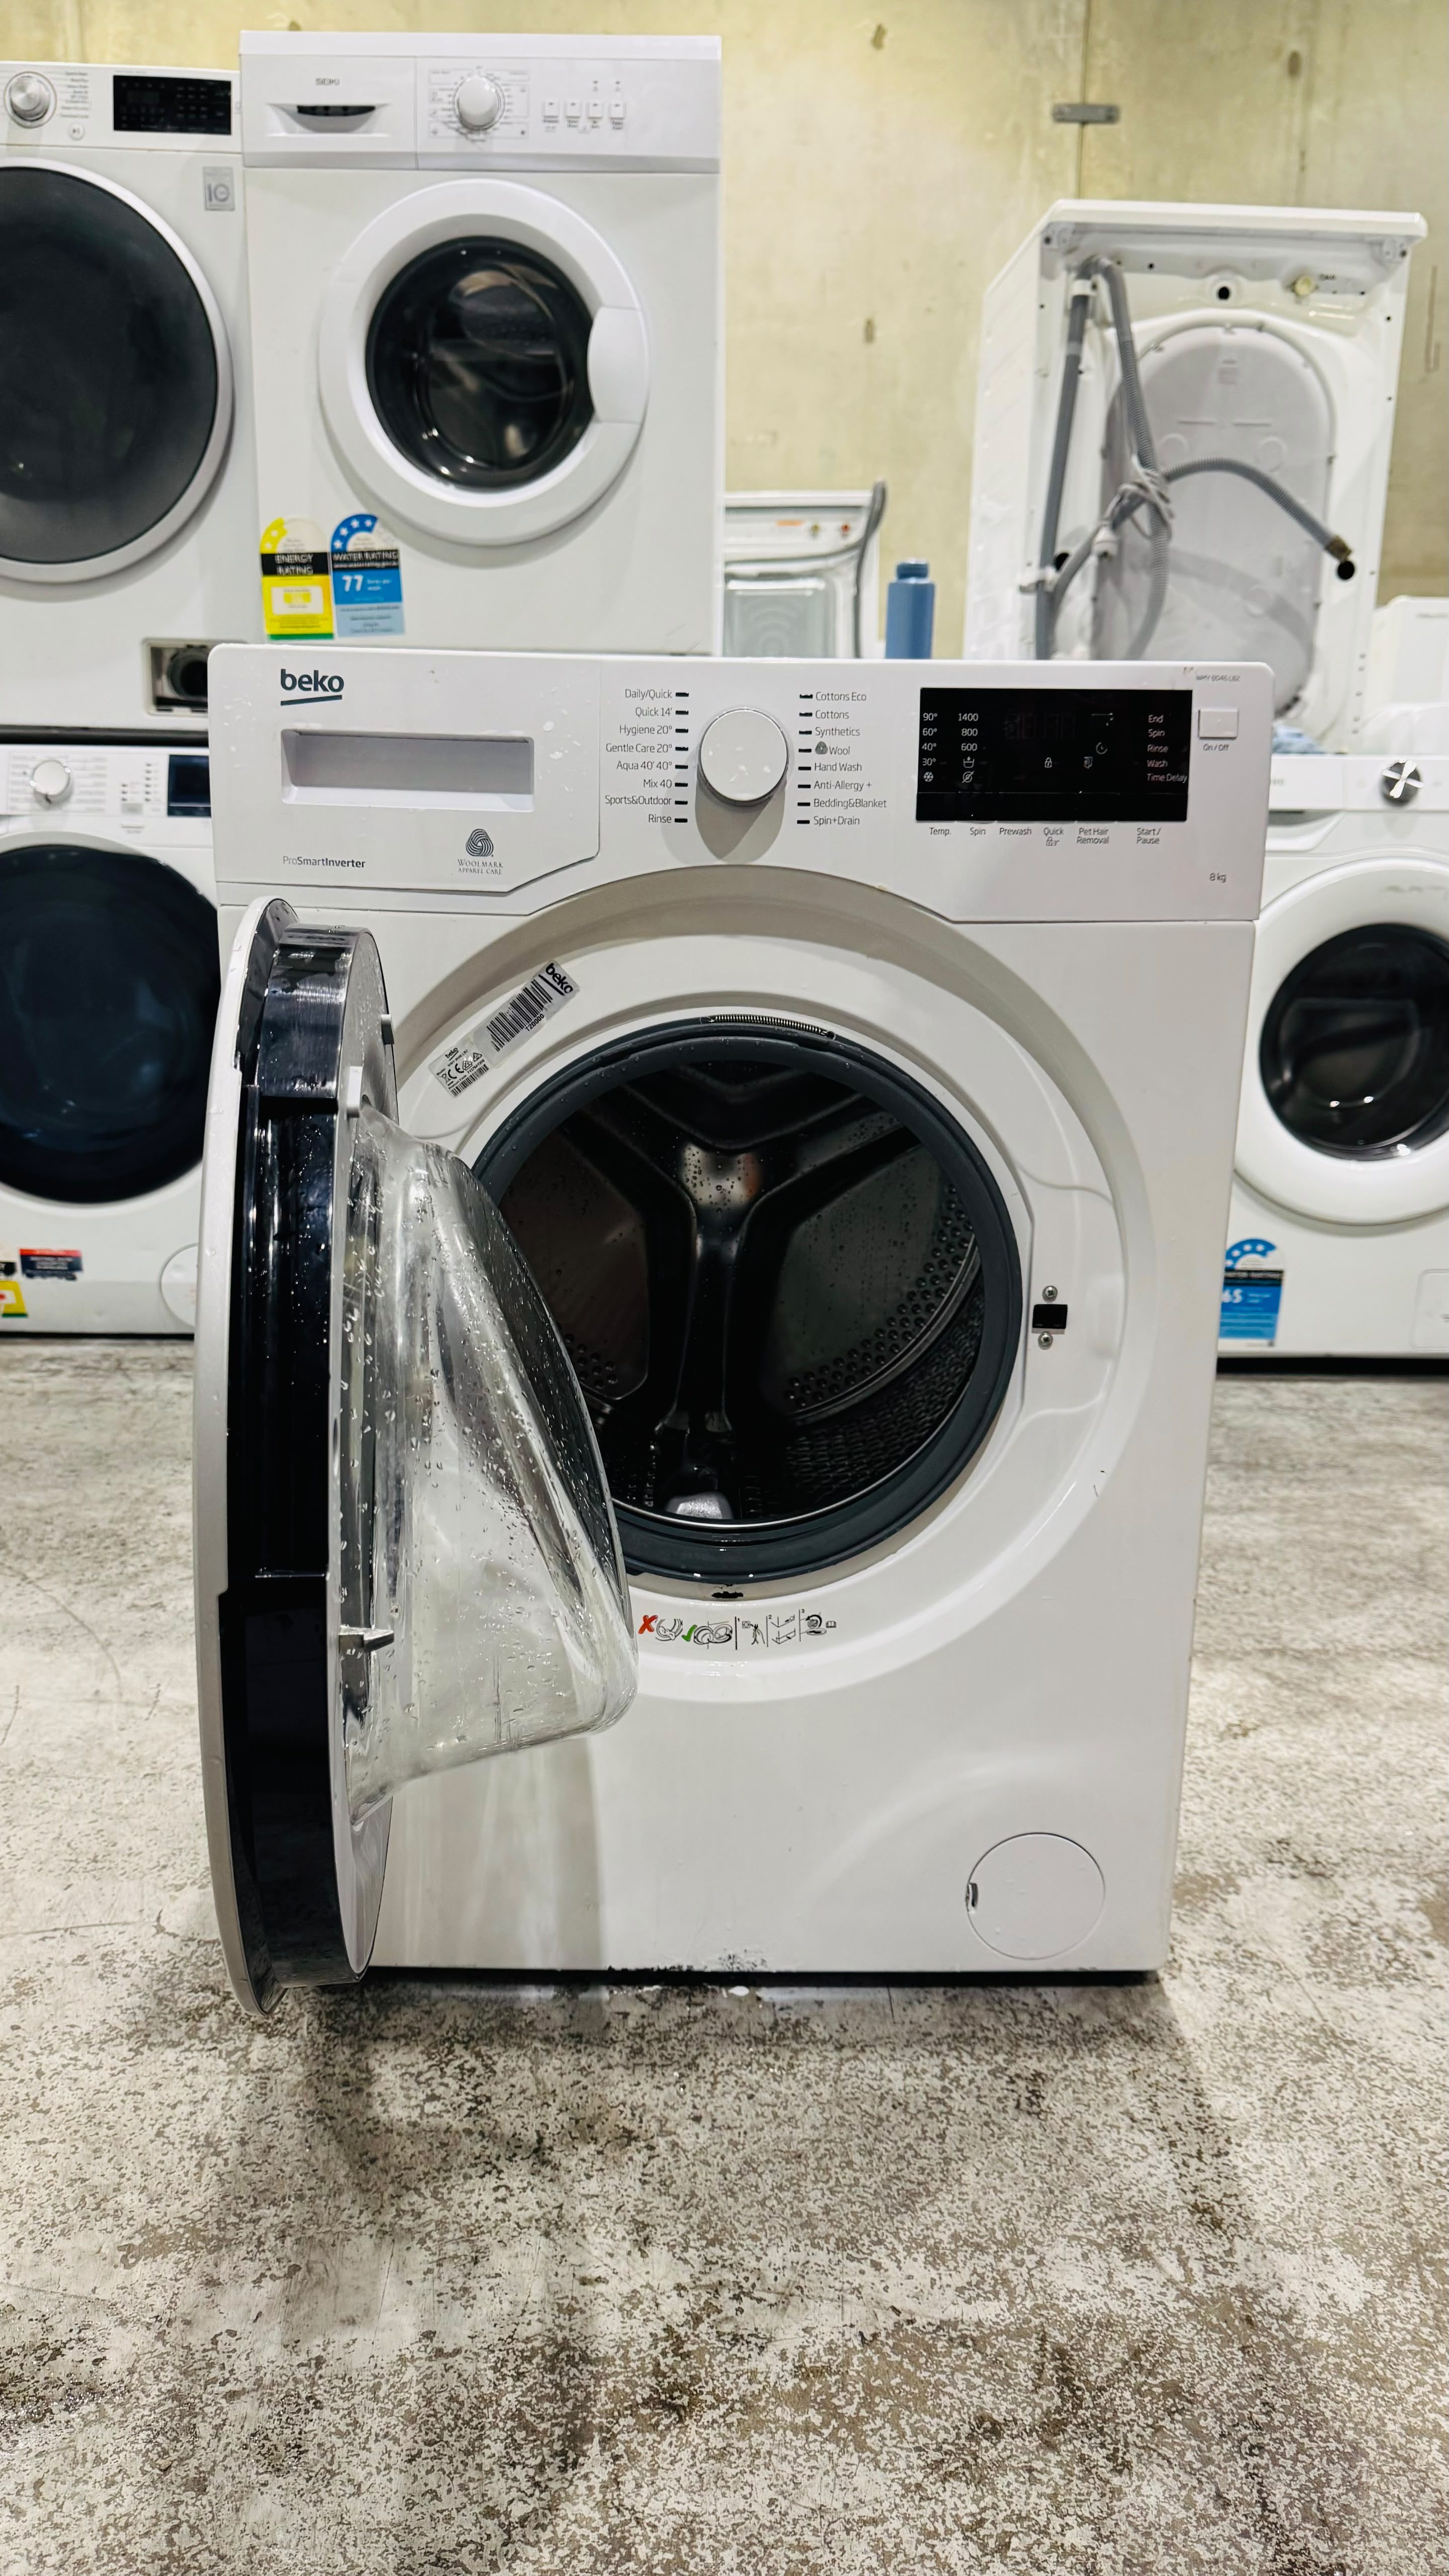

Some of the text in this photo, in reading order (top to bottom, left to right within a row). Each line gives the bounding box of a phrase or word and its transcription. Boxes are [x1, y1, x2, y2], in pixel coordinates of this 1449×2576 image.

[275, 553, 313, 564] ENERGY
[333, 551, 398, 561] WATER RATING
[276, 565, 313, 575] RATING
[342, 575, 363, 592] 77
[281, 669, 344, 692] beko
[625, 689, 672, 700] Daily/Quick
[816, 692, 867, 701] Cottons Eco
[635, 707, 659, 718] Quick
[815, 710, 849, 719] Cottons
[958, 713, 979, 721] 1400
[1148, 714, 1164, 723] End
[619, 725, 655, 736] Hygiene
[815, 727, 860, 738] Synthetics
[961, 728, 978, 737] 800
[1148, 729, 1165, 738] Spin
[606, 743, 634, 753] Gentle
[635, 744, 655, 753] Care
[829, 746, 850, 755] Wool
[961, 743, 978, 751] 600
[1147, 744, 1168, 753] Rinse
[616, 760, 638, 771] Aqua
[814, 762, 862, 772] Hand Wash
[1147, 759, 1168, 768] Wash
[1147, 773, 1187, 783] Time Delay
[643, 779, 672, 788] Mix 40
[814, 780, 864, 792] Anti-Allergy
[605, 795, 672, 806] Sports&Outdoor
[814, 798, 887, 810] Bedding&Blanket
[648, 814, 672, 823] Rinse
[814, 816, 860, 827] Spin+Drain
[970, 827, 986, 836] Spin
[999, 827, 1032, 836] Prewash
[1043, 827, 1064, 837] Quick
[1079, 827, 1109, 836] Pet Hair
[1137, 827, 1155, 836] Start
[1076, 836, 1110, 844] Removal
[1136, 836, 1160, 844] Pause
[283, 855, 366, 868] ProSmartInverter
[457, 858, 503, 868] WOOLMARK
[1217, 873, 1227, 883] kg
[545, 962, 574, 994] beko
[525, 1013, 544, 1031] T20000
[445, 1048, 458, 1059] beko
